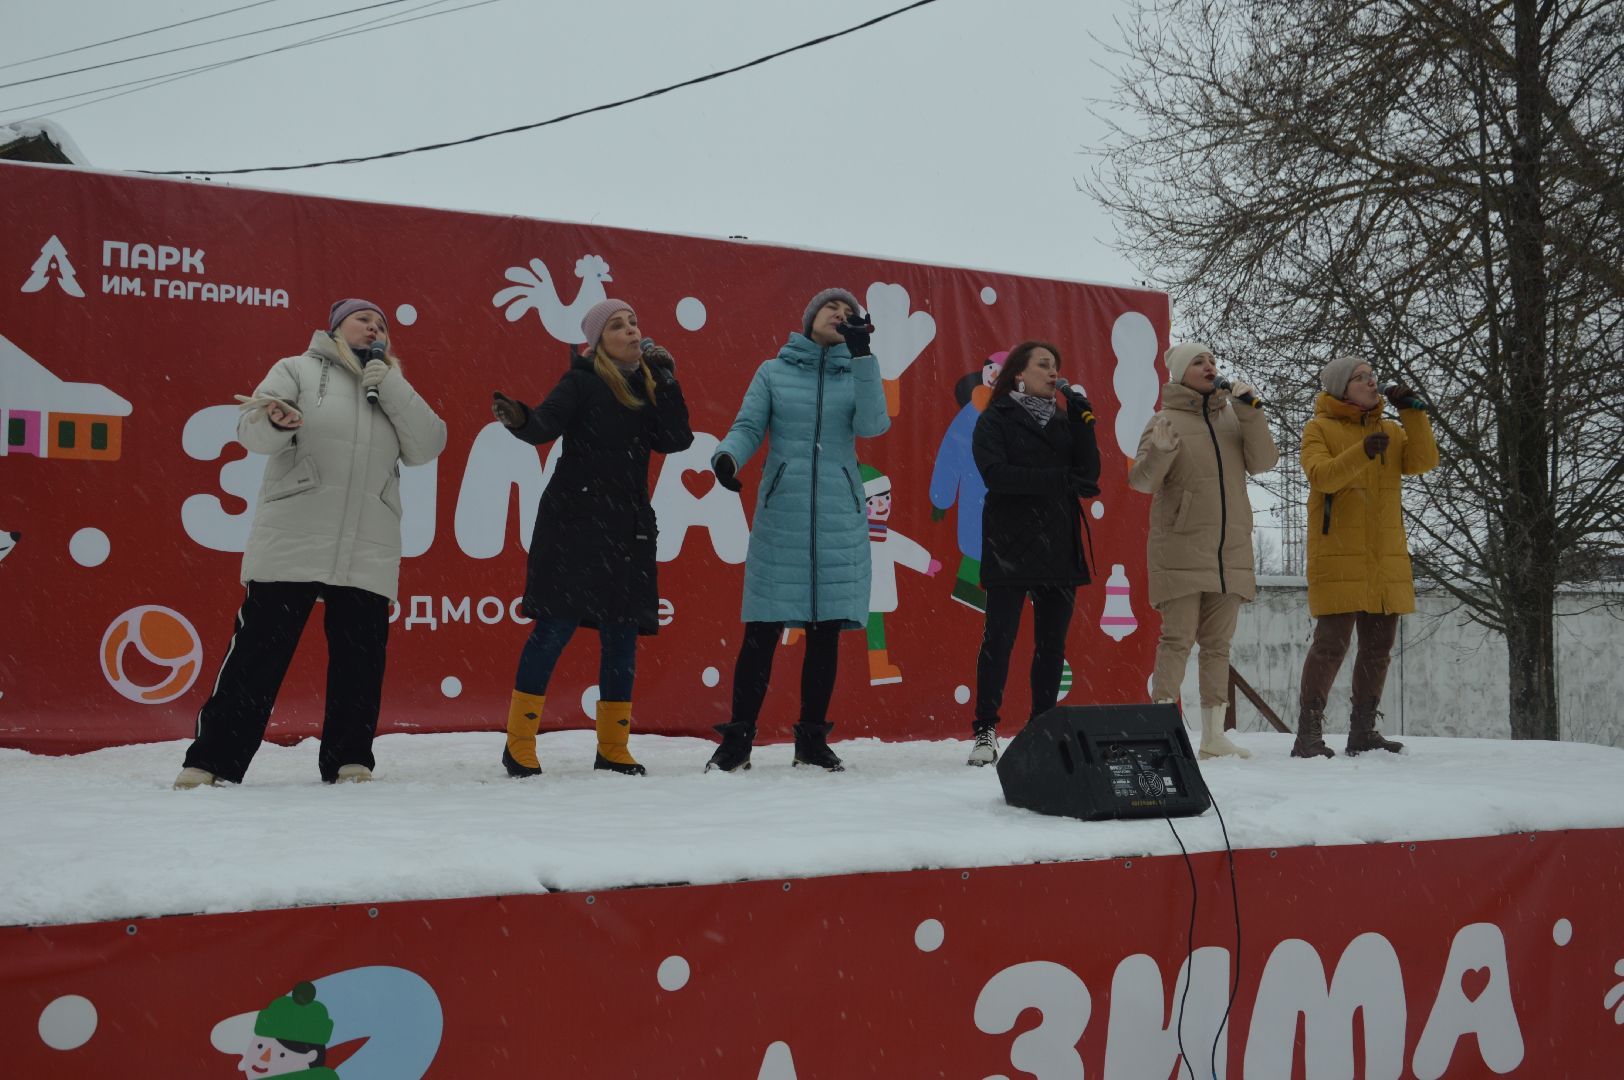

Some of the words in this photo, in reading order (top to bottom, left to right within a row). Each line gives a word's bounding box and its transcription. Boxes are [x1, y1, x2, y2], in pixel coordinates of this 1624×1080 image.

[102, 240, 206, 275] ПАРК
[102, 274, 146, 297] ИМ.
[153, 278, 289, 309] ГАГАРИНА
[974, 922, 1525, 1080] ЗИМА
